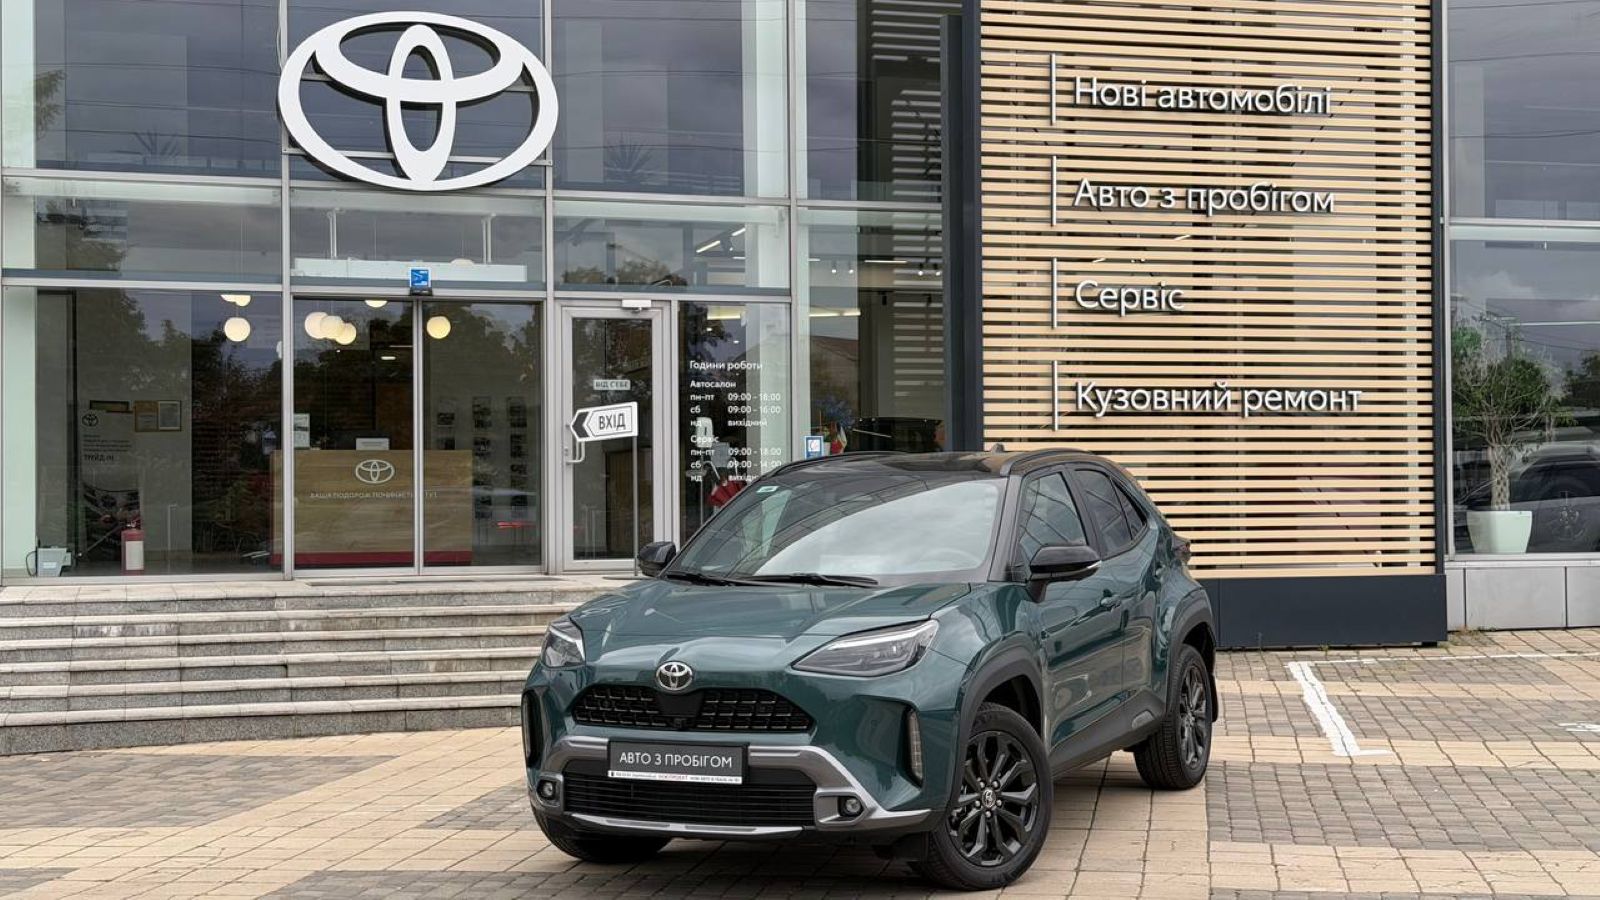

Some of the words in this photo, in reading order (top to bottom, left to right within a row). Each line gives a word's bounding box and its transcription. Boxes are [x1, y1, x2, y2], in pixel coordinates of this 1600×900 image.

[1073, 76, 1148, 107] Нові
[1157, 83, 1333, 114] автомобілі
[1073, 178, 1150, 208] Авто
[1159, 186, 1176, 208] з
[1187, 182, 1335, 217] пробігом
[1075, 280, 1186, 317] Сервіс
[689, 360, 726, 372] Години
[727, 360, 763, 371] роботи
[689, 380, 737, 389] Автосалон
[727, 392, 752, 401] 09:00
[1076, 381, 1233, 417] Кузовний
[1243, 389, 1364, 418] ремонт
[690, 405, 701, 414] сб
[727, 405, 752, 414] 09:00
[598, 413, 626, 430] ВХІД
[727, 447, 752, 456] 09:00
[727, 460, 752, 468] 09:00
[727, 473, 760, 482] вихідн
[620, 752, 651, 764] АВТО
[664, 754, 732, 768] ПРОБІГОМ
